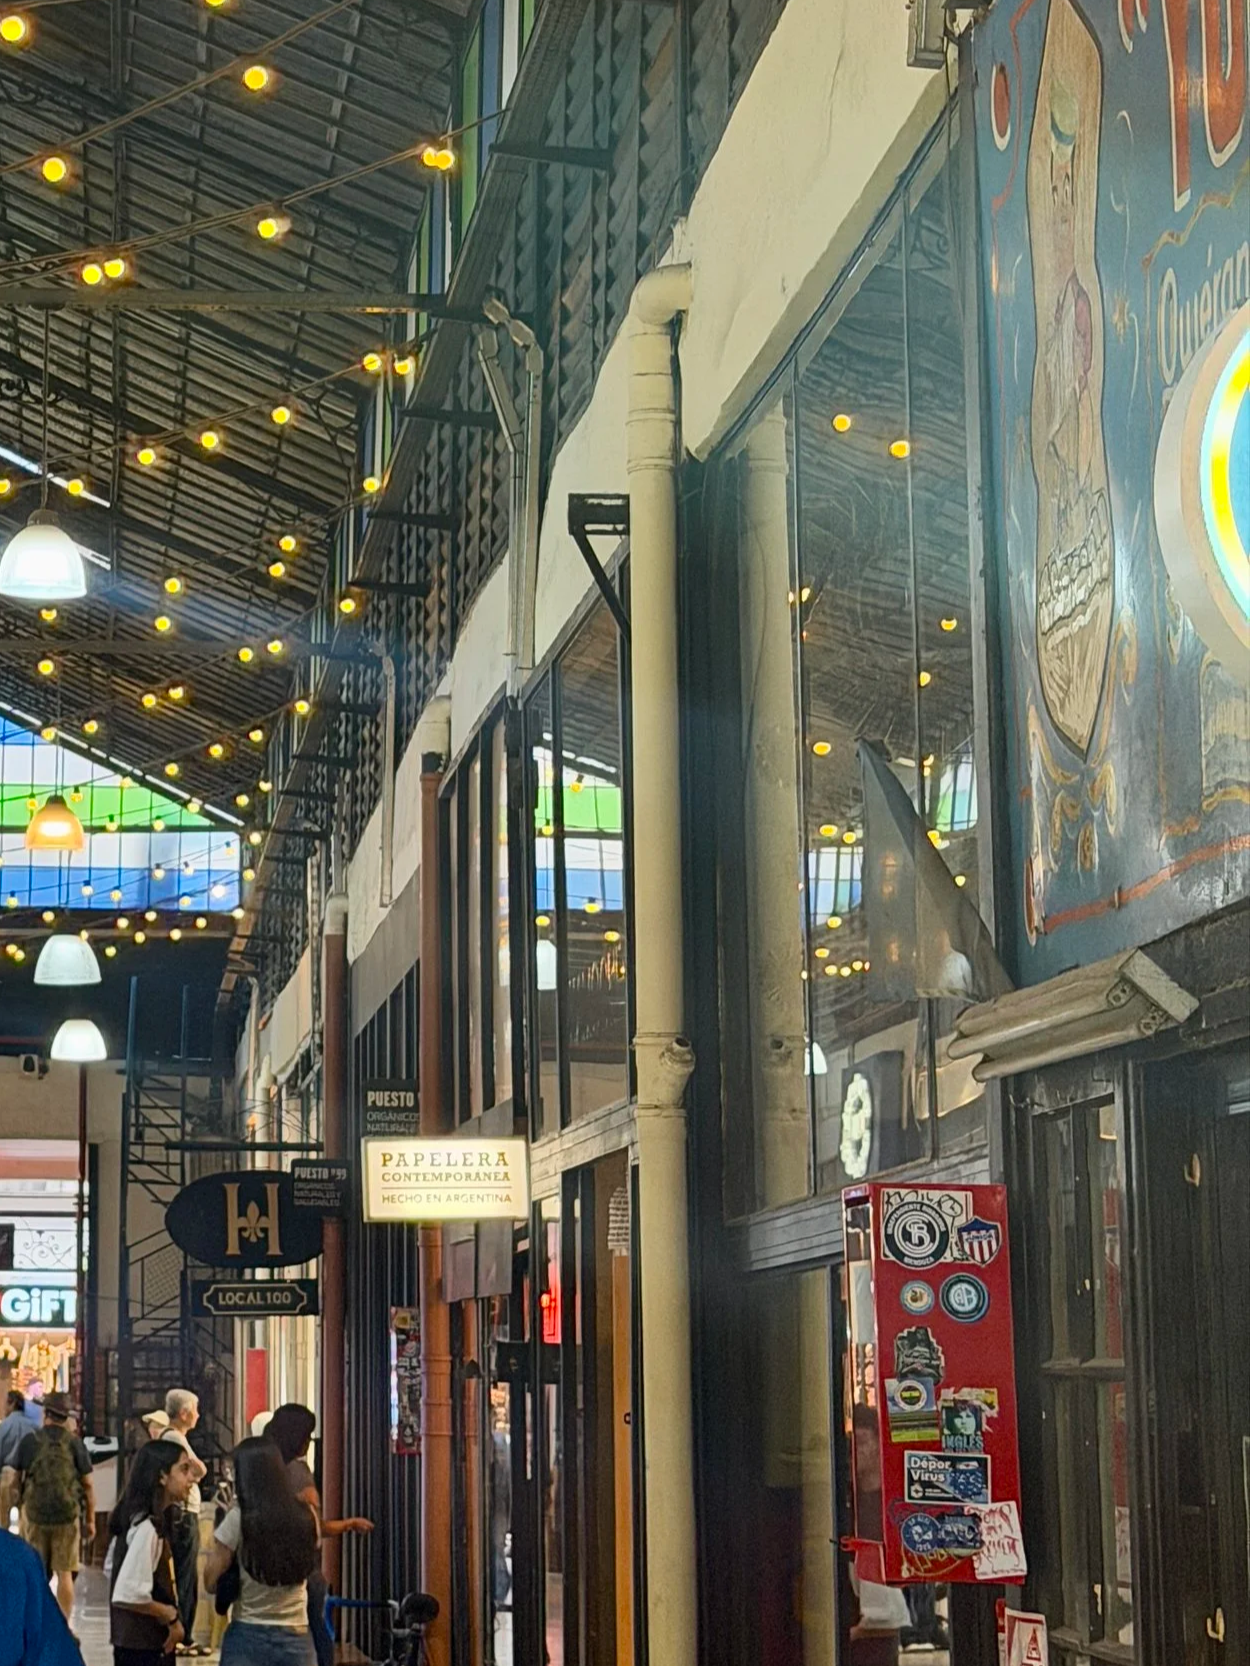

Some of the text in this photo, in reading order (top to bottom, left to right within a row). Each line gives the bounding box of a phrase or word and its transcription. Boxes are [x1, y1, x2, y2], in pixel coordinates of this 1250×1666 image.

[366, 1090, 415, 1108] PUESTO
[381, 1152, 509, 1167] PAPELERA
[294, 1167, 329, 1179] PUESTO
[381, 1170, 511, 1182] CONTEMPORÁNEA
[382, 1193, 513, 1204] HECHO EN ARGENTINA
[222, 1182, 284, 1256] H
[218, 1291, 291, 1305] LOCAL 100
[910, 1456, 951, 1471] Dépor
[910, 1469, 945, 1482] Virus
